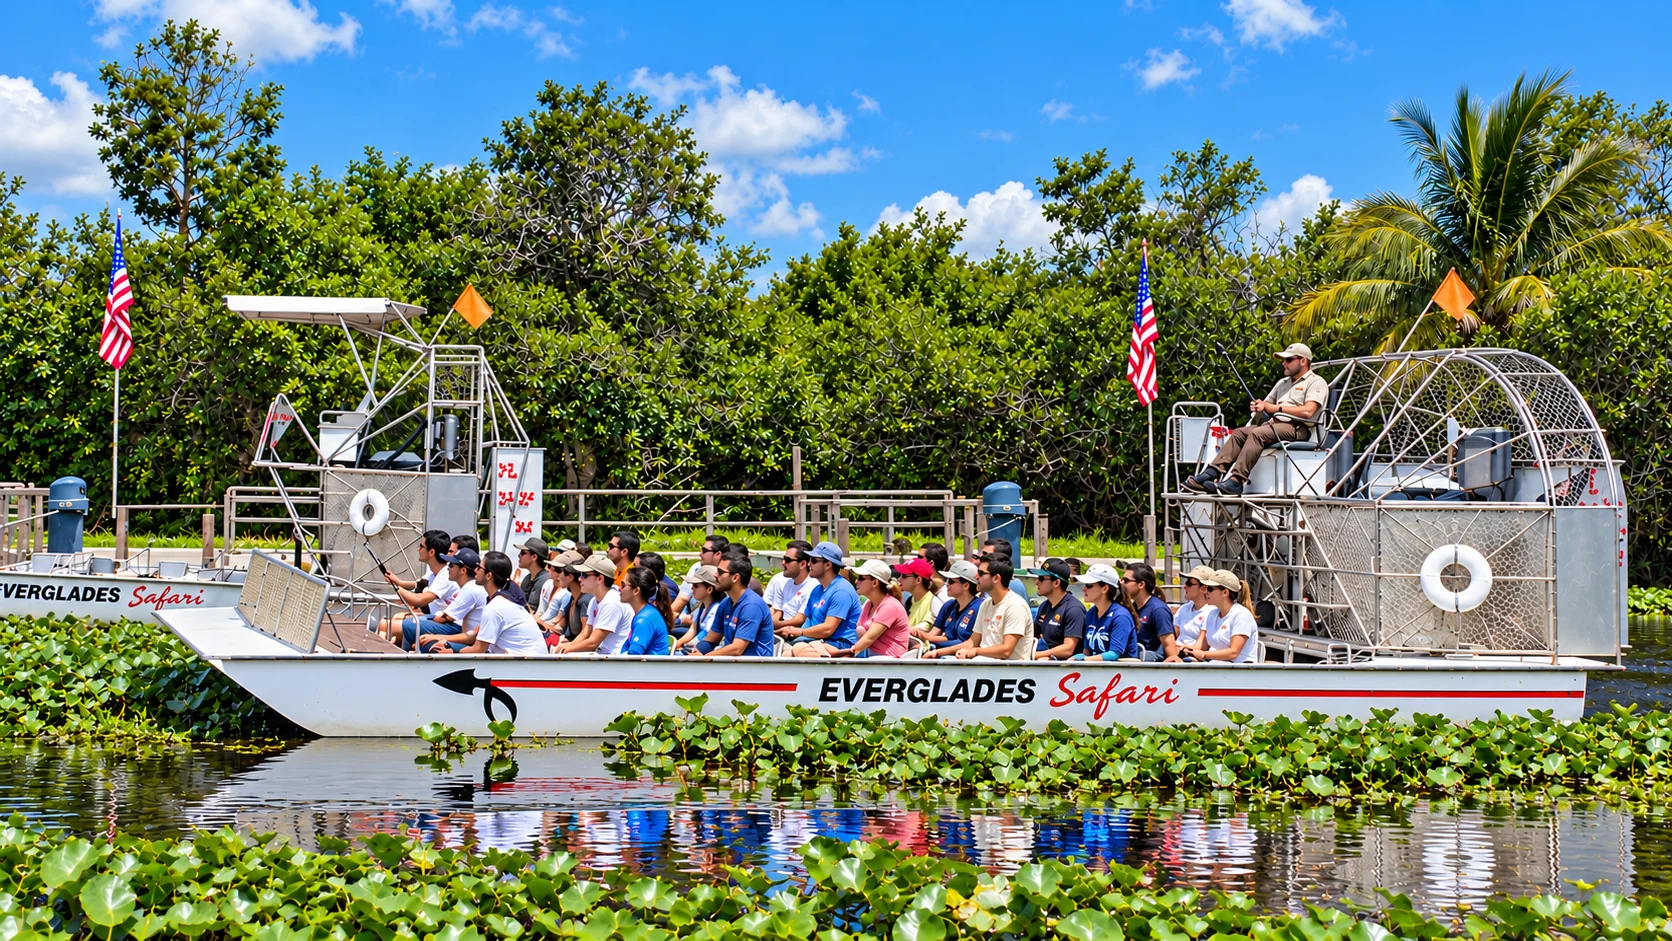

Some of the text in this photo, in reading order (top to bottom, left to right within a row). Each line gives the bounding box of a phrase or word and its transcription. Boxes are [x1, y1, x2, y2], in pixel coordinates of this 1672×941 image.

[0, 583, 204, 610] VERGLADES Safari
[819, 671, 1179, 721] EVERGLADES Safari
